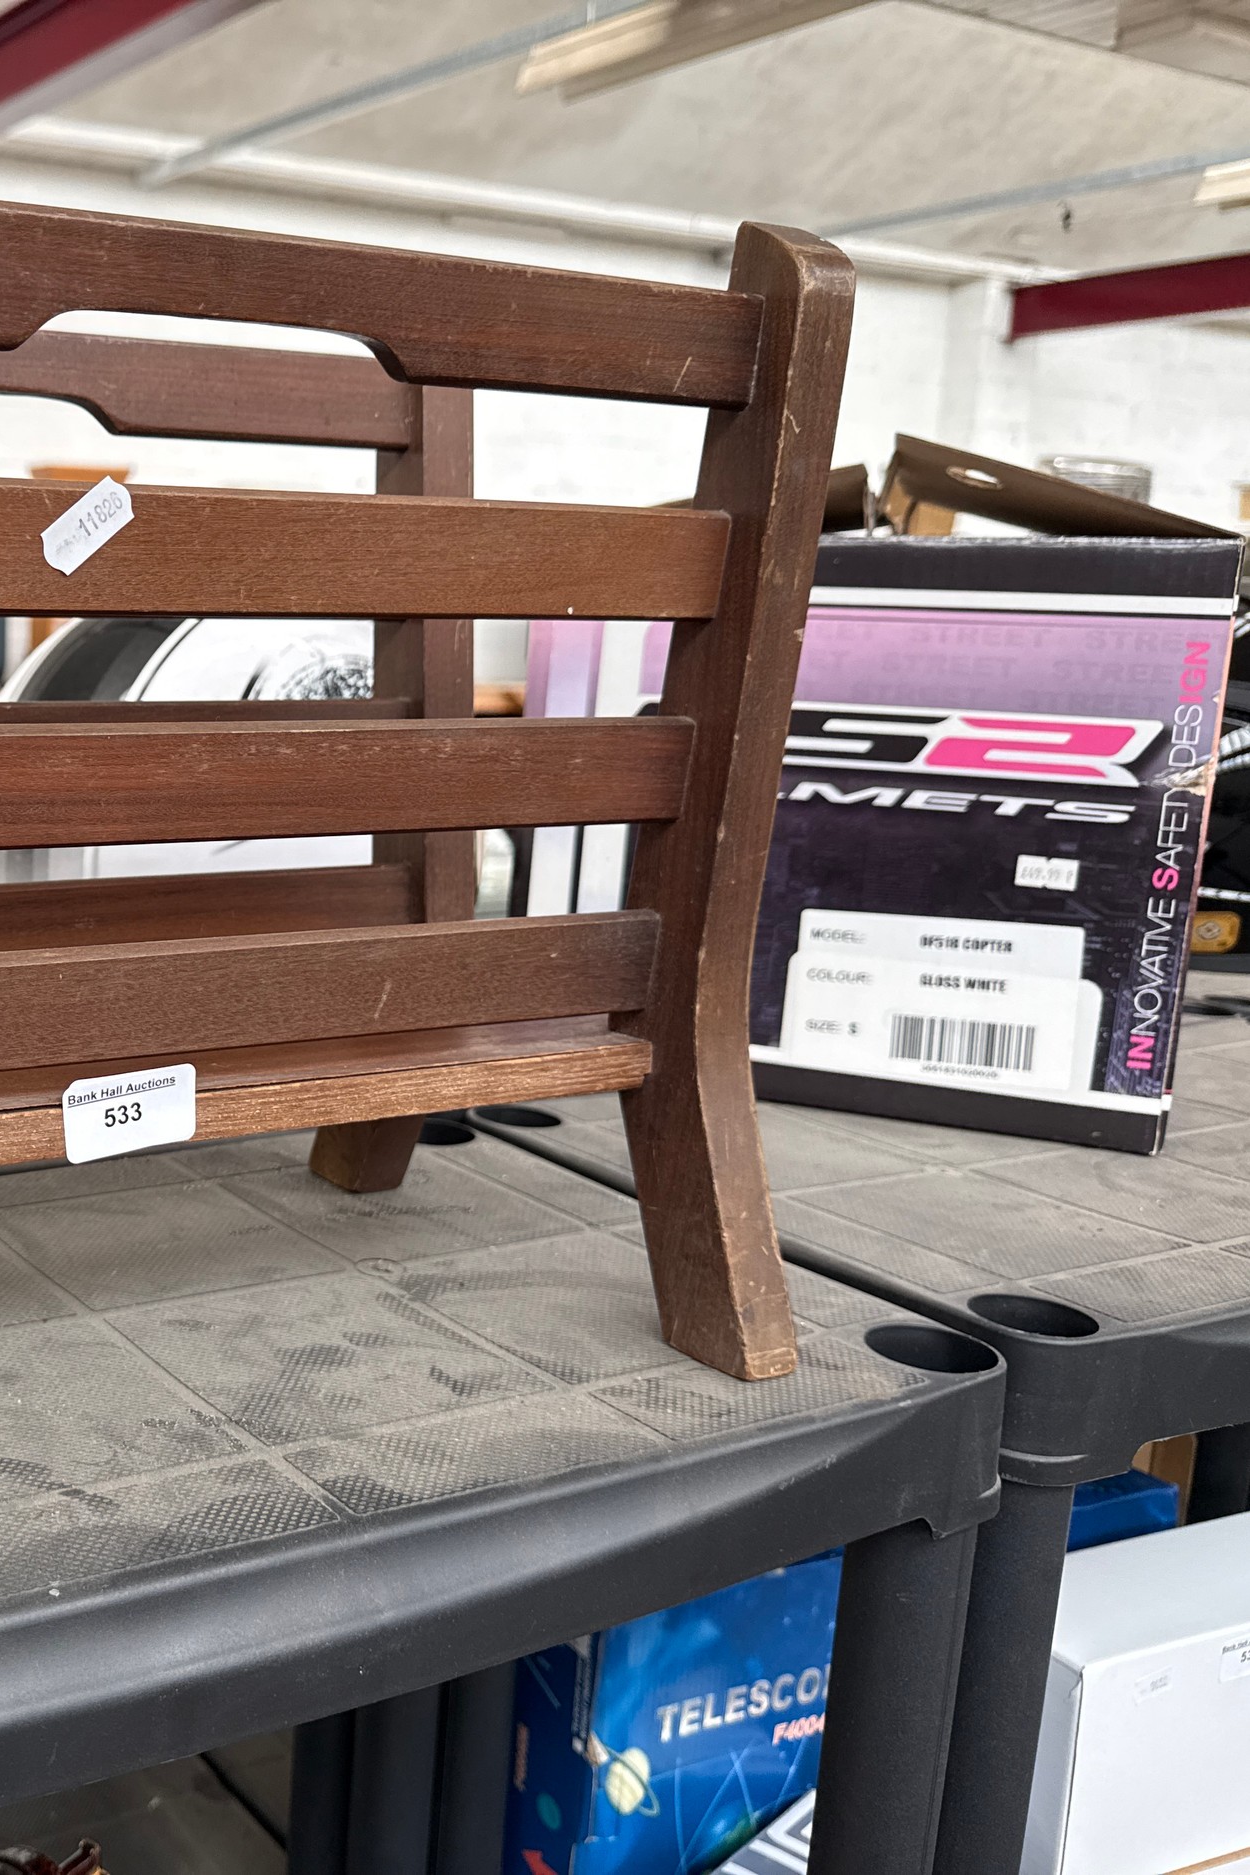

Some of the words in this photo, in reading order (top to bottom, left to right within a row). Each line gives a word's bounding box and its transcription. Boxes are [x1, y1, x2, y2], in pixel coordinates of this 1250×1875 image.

[79, 491, 123, 537] 11826
[786, 703, 1163, 787] S2
[777, 782, 1136, 824] METS
[1126, 897, 1176, 1070] INNOVATIVE
[1169, 641, 1211, 767] DESIGN
[963, 976, 1007, 993] WHITE
[67, 1091, 97, 1105] Bank
[101, 1085, 123, 1098] Hall
[126, 1076, 176, 1093] Auctions
[104, 1102, 142, 1128] 533
[656, 1663, 831, 1743] TELESCO
